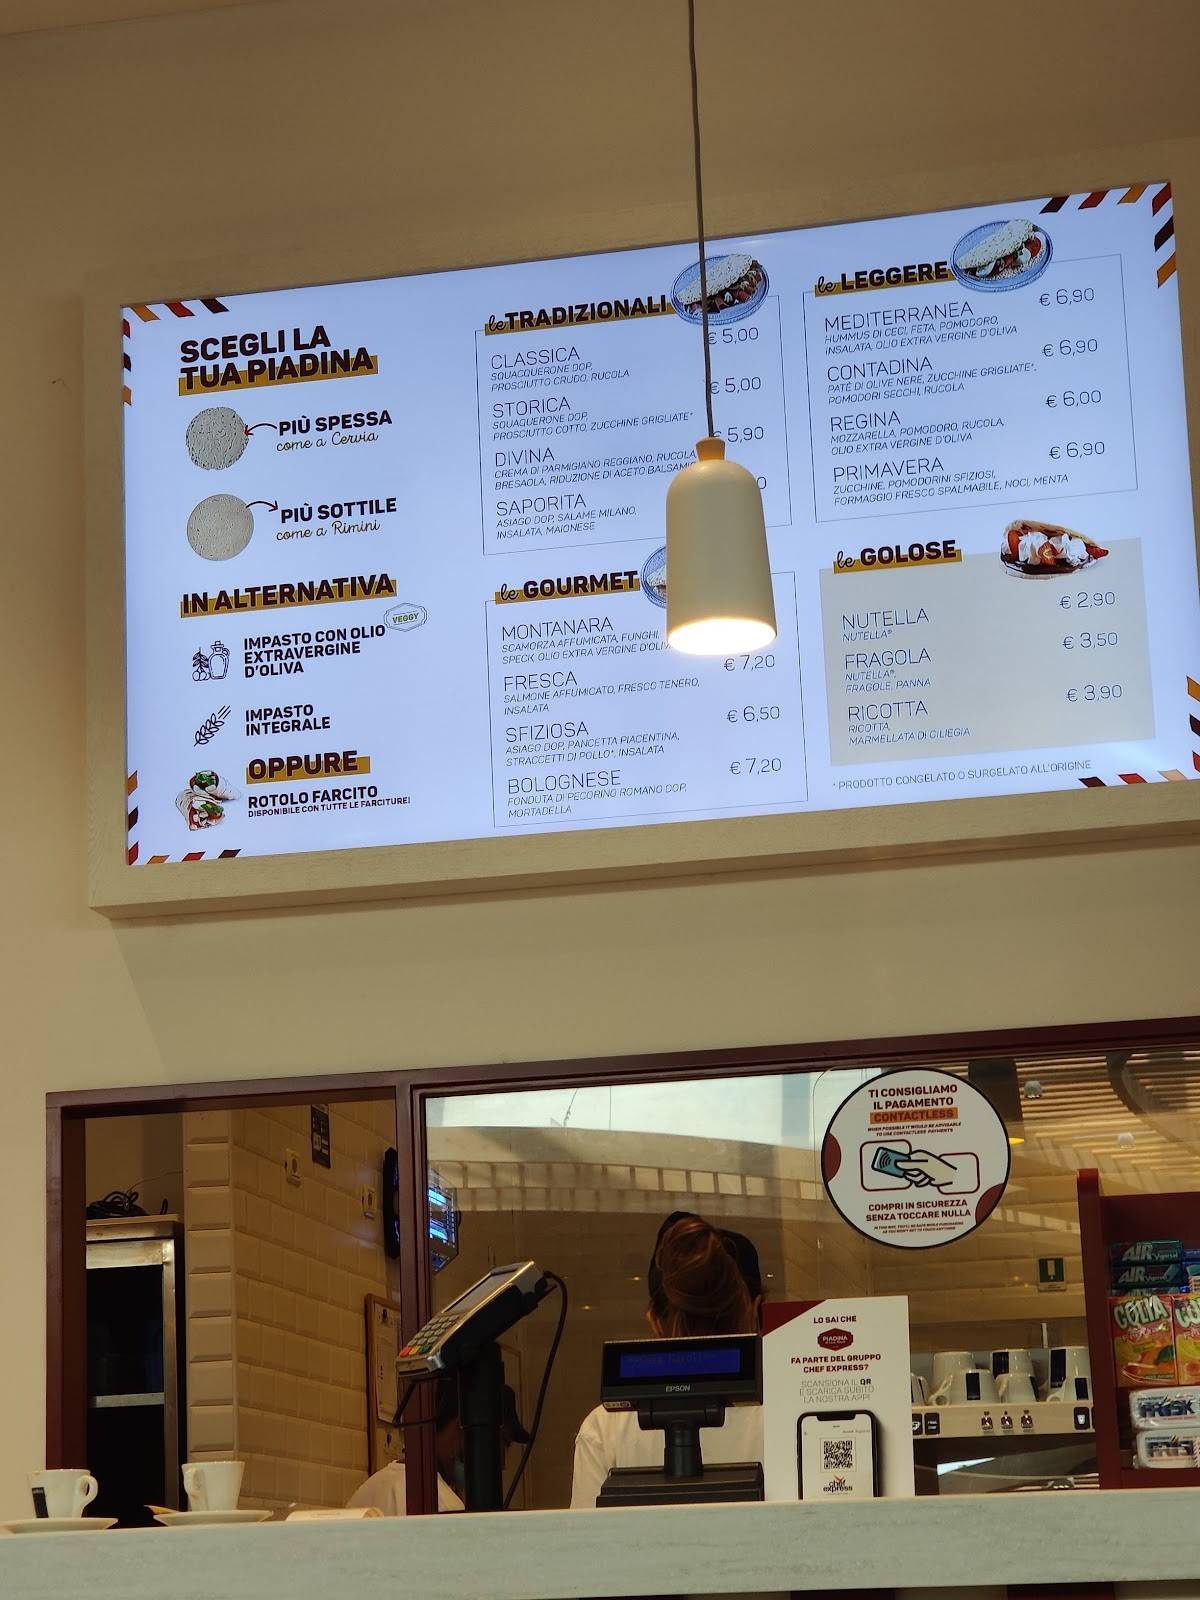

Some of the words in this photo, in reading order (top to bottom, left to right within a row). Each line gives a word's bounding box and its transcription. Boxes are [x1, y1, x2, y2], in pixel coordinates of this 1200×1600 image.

[817, 274, 836, 293] le
[841, 260, 948, 290] LEGGERE
[1038, 293, 1050, 306] €
[1056, 287, 1094, 304] 6,90
[488, 312, 506, 331] le
[504, 294, 666, 330] TRADIZIONALI
[824, 300, 973, 332] MEDITERRANEA
[180, 328, 285, 364] SCEGLI
[292, 323, 331, 351] LA
[721, 324, 759, 345] 5,00
[490, 345, 580, 369] CLASSICA
[1041, 343, 1054, 357] €
[1059, 337, 1097, 356] 6,90
[180, 360, 242, 390] TUA
[247, 345, 374, 383] PIADINA
[827, 355, 933, 381] CONTADINA
[724, 373, 762, 395] 5,00
[492, 396, 570, 418] STORICA
[1044, 394, 1057, 408] €
[1062, 389, 1101, 407] 6,00
[278, 414, 310, 436] PIÙ
[314, 408, 392, 432] SPESSA
[830, 410, 901, 432] REGINA
[275, 437, 312, 452] come
[316, 437, 326, 447] a
[330, 427, 379, 446] Cervia
[727, 423, 765, 445] 5,90
[495, 447, 554, 467] DIVINA
[1048, 445, 1060, 460] €
[1063, 441, 1104, 458] 6,90
[833, 456, 944, 482] PRIMAVERA
[280, 502, 312, 523] PIÙ
[316, 496, 397, 520] SOTTILE
[496, 493, 586, 516] SAPORITA
[276, 527, 312, 541] come
[315, 526, 327, 537] a
[331, 516, 381, 536] Rimini
[836, 549, 855, 568] le
[859, 539, 956, 566] GOLOSE
[183, 591, 208, 614] IN
[213, 572, 394, 611] ALTERNATIVA
[500, 582, 519, 601] le
[523, 570, 638, 599] GOURMET
[1058, 594, 1071, 609] €
[1077, 591, 1115, 608] 2,90
[392, 612, 418, 624] VEGGY
[501, 615, 613, 641] MONTANARA
[842, 607, 929, 630] NUTELLA
[243, 631, 311, 650] IMPASTO
[314, 627, 347, 644] CON
[350, 624, 385, 639] OLIO
[1061, 634, 1074, 649] €
[1079, 631, 1117, 648] 3,50
[244, 640, 360, 664] EXTRAVERGINE
[723, 657, 735, 671] €
[739, 654, 775, 671] 7,20
[844, 647, 932, 670] FRAGOLA
[244, 660, 304, 678] D'OLIVA
[503, 670, 577, 691] FRESCA
[1065, 687, 1078, 702] €
[1081, 684, 1122, 701] 3,90
[245, 703, 313, 722] IMPASTO
[725, 709, 738, 723] €
[743, 705, 779, 722] 6,50
[848, 699, 928, 722] RICOTTA
[245, 715, 330, 736] INTEGRALE
[505, 720, 589, 742] SFIZIOSA
[248, 749, 357, 780] OPPURE
[728, 761, 741, 776] €
[745, 757, 781, 775] 7,20
[838, 776, 892, 789] PRODOTTO
[895, 771, 955, 784] CONGELATO
[957, 771, 965, 779] O
[967, 765, 1028, 778] SURGELATO
[1030, 759, 1091, 773] ALL'ORIGINE
[507, 769, 620, 794] BOLOGNESE
[247, 791, 308, 809] ROTOLO
[312, 785, 377, 803] FARCITO
[247, 805, 300, 817] DISPONIBILE
[300, 804, 319, 812] CON
[320, 801, 347, 811] TUTTE
[349, 800, 359, 808] LE
[360, 796, 410, 807] FARCITURE!
[868, 1089, 878, 1098] TI
[880, 1084, 958, 1097] CONSIGLIAMO
[873, 1101, 883, 1110] IL
[885, 1097, 954, 1109] PAGAMENTO
[874, 1109, 954, 1123] CONTACTLESS
[866, 1213, 896, 1222] SENZA
[897, 1211, 940, 1220] TOCCARE
[941, 1209, 971, 1218] NULLA
[869, 1202, 903, 1211] COMPRI
[916, 1199, 968, 1209] SICUREZZA
[840, 1315, 857, 1323] CHE
[802, 1356, 829, 1364] PARTE
[830, 1355, 846, 1363] DEL
[847, 1353, 881, 1361] GRUPPO
[803, 1365, 824, 1374] CHEF
[826, 1363, 869, 1373] EXPRESS?
[665, 1384, 691, 1393] EPSON
[823, 1485, 853, 1493] express
